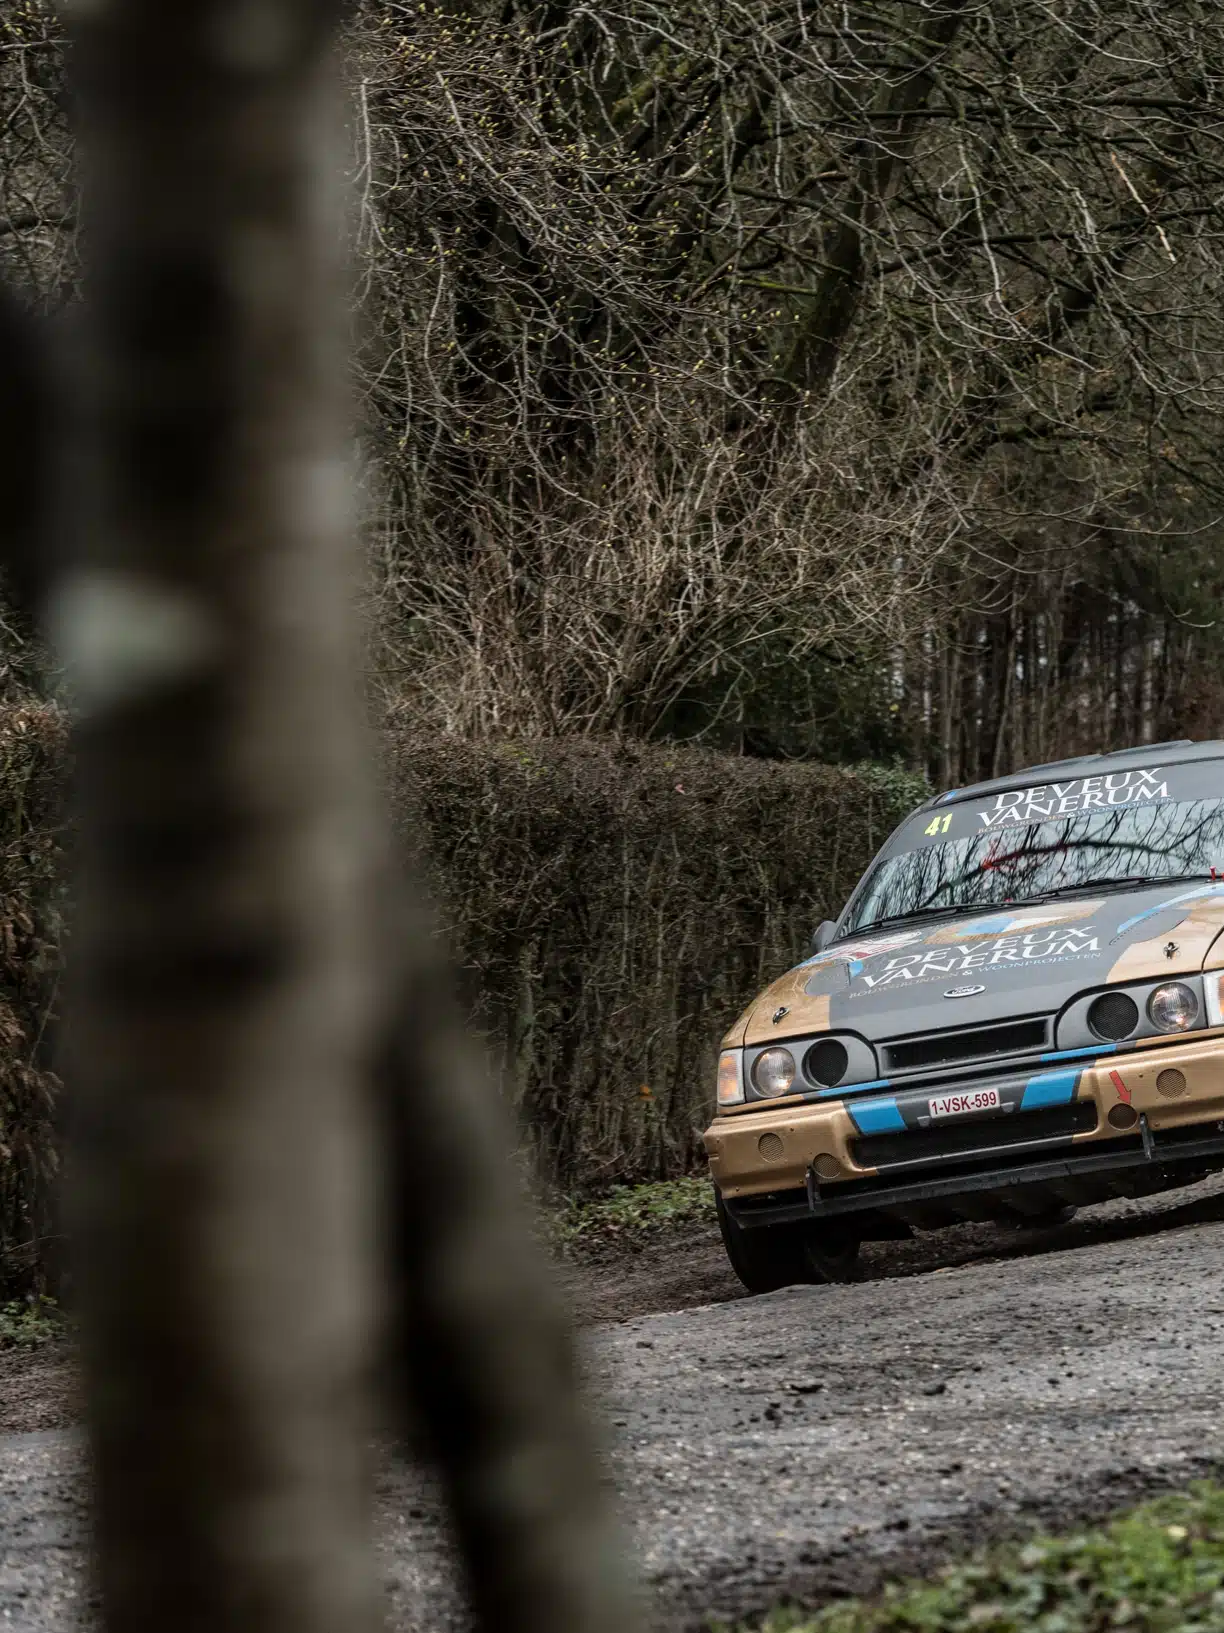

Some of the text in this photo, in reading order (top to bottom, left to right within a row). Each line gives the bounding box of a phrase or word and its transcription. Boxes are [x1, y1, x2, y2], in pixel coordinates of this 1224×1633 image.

[976, 781, 1172, 827] VANERUM
[992, 767, 1162, 811] DEVEUX
[924, 812, 953, 837] 41
[860, 937, 1103, 988] VANERUM
[881, 926, 1097, 972] DEVEUX
[931, 1091, 997, 1115] 1-VSK-599
